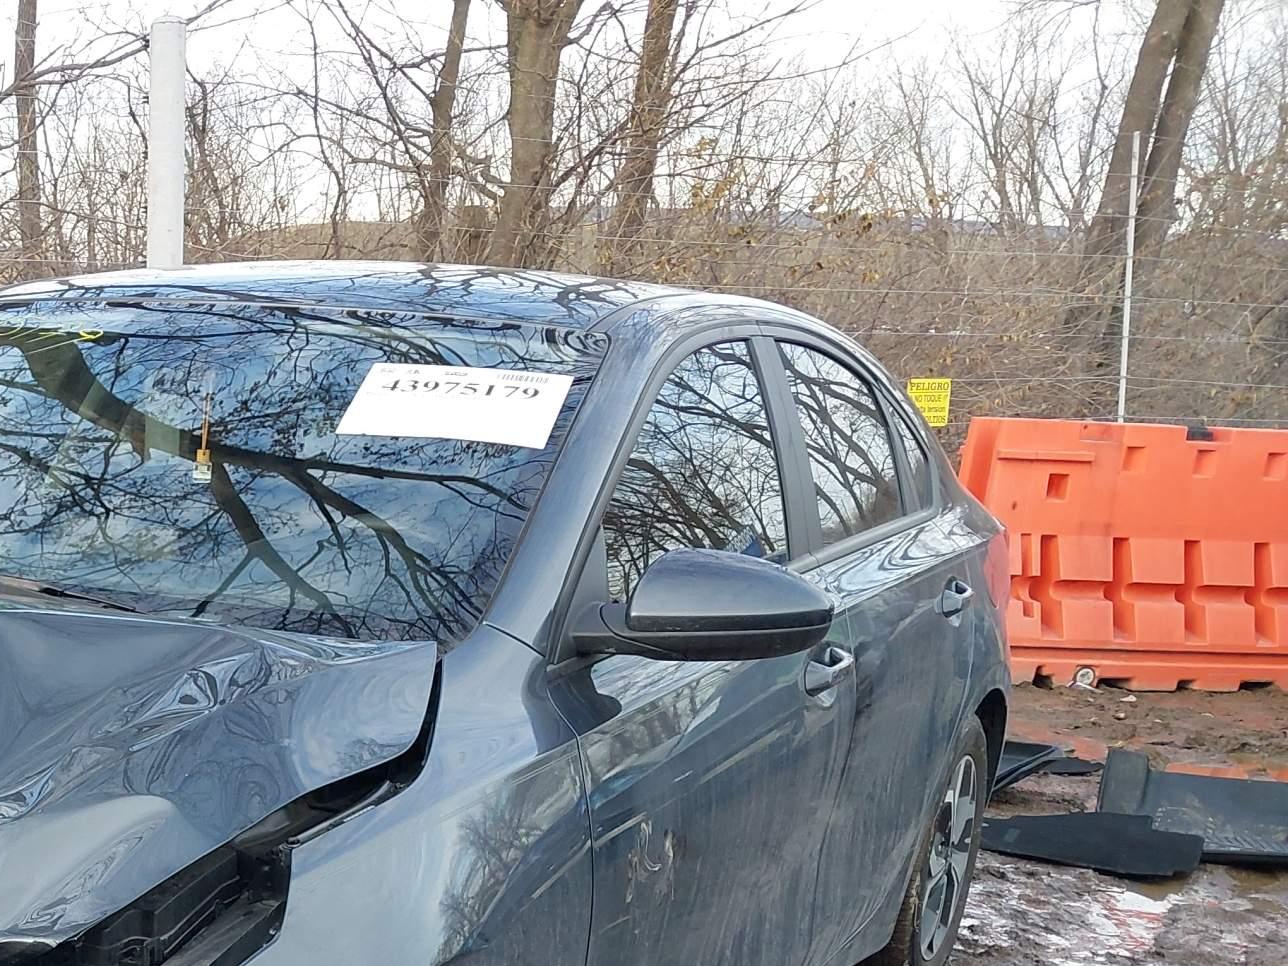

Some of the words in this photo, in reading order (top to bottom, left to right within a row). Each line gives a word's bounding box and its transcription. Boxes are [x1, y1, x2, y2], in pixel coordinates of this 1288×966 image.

[381, 379, 540, 399] 43975179
[910, 382, 950, 391] PELIGRO
[924, 394, 942, 402] TOQUE
